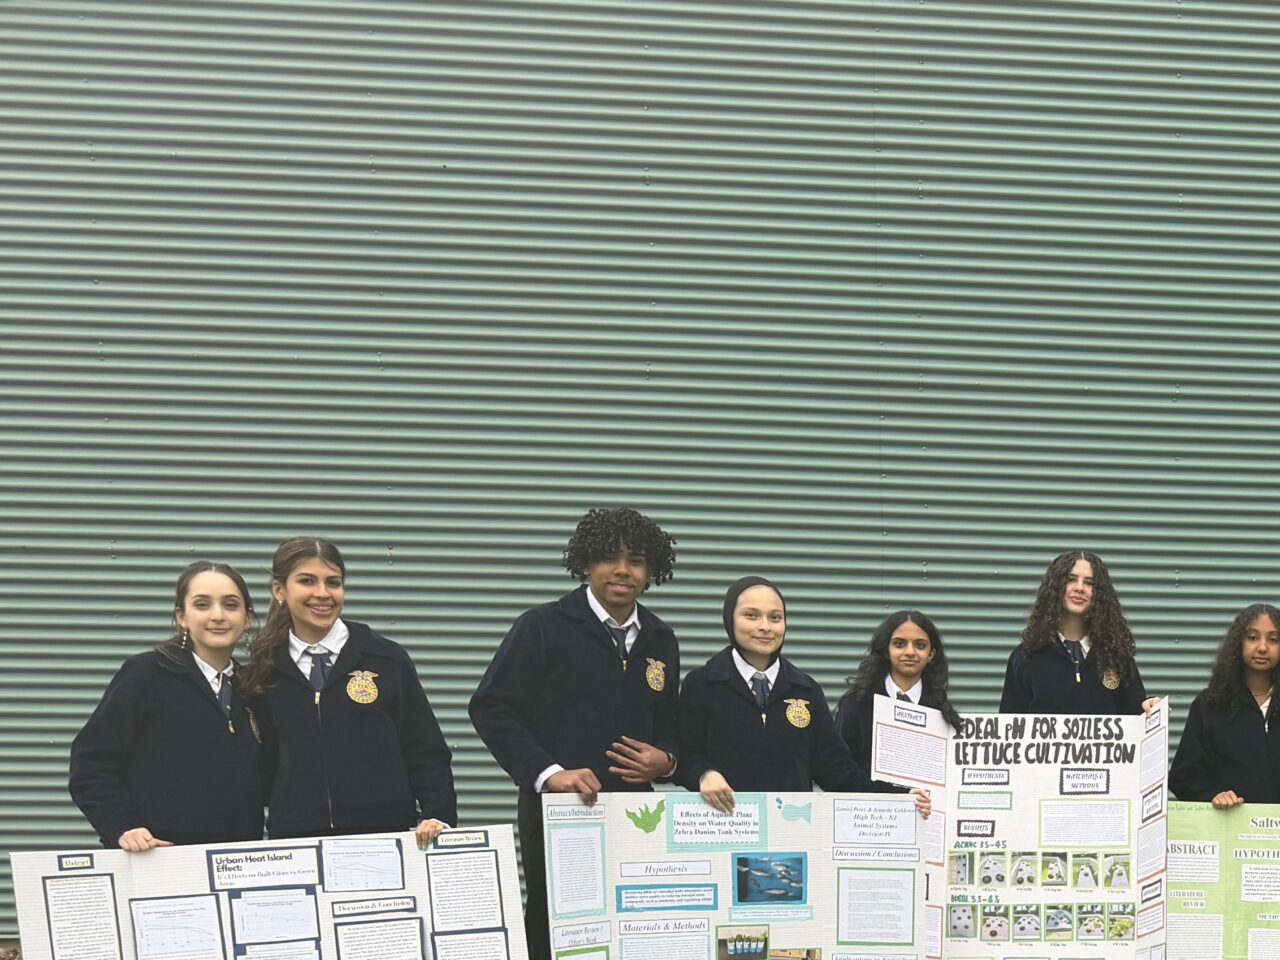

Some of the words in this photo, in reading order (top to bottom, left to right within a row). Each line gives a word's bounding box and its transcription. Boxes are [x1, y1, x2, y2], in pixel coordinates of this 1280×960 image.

[953, 717, 1001, 740] IDEAL
[1005, 717, 1027, 741] pH
[1031, 717, 1057, 740] FOR
[1061, 717, 1124, 741] SOILESS
[954, 742, 1022, 765] LETTUCE
[1024, 742, 1136, 765] CULTIVATION
[967, 772, 1005, 780] HYPOTHESIS
[680, 810, 702, 818] Effects
[702, 810, 710, 818] of
[736, 810, 753, 818] Plant
[673, 819, 697, 828] Density
[728, 819, 751, 828] Quality
[875, 822, 898, 830] Systems
[734, 829, 759, 837] Systems
[835, 849, 872, 858] Discussion
[878, 849, 918, 859] Conclusions
[64, 859, 89, 868] Abstract
[215, 856, 244, 865] Urban
[245, 855, 266, 864] Heat
[267, 853, 293, 862] Island
[216, 864, 243, 873] Effect:
[644, 864, 689, 875] Hypothesis
[338, 902, 371, 912] Discussion
[371, 901, 378, 910] &
[378, 900, 412, 909] Conclusion
[622, 922, 662, 932] Materials
[663, 922, 671, 931] &
[672, 921, 706, 931] Methods
